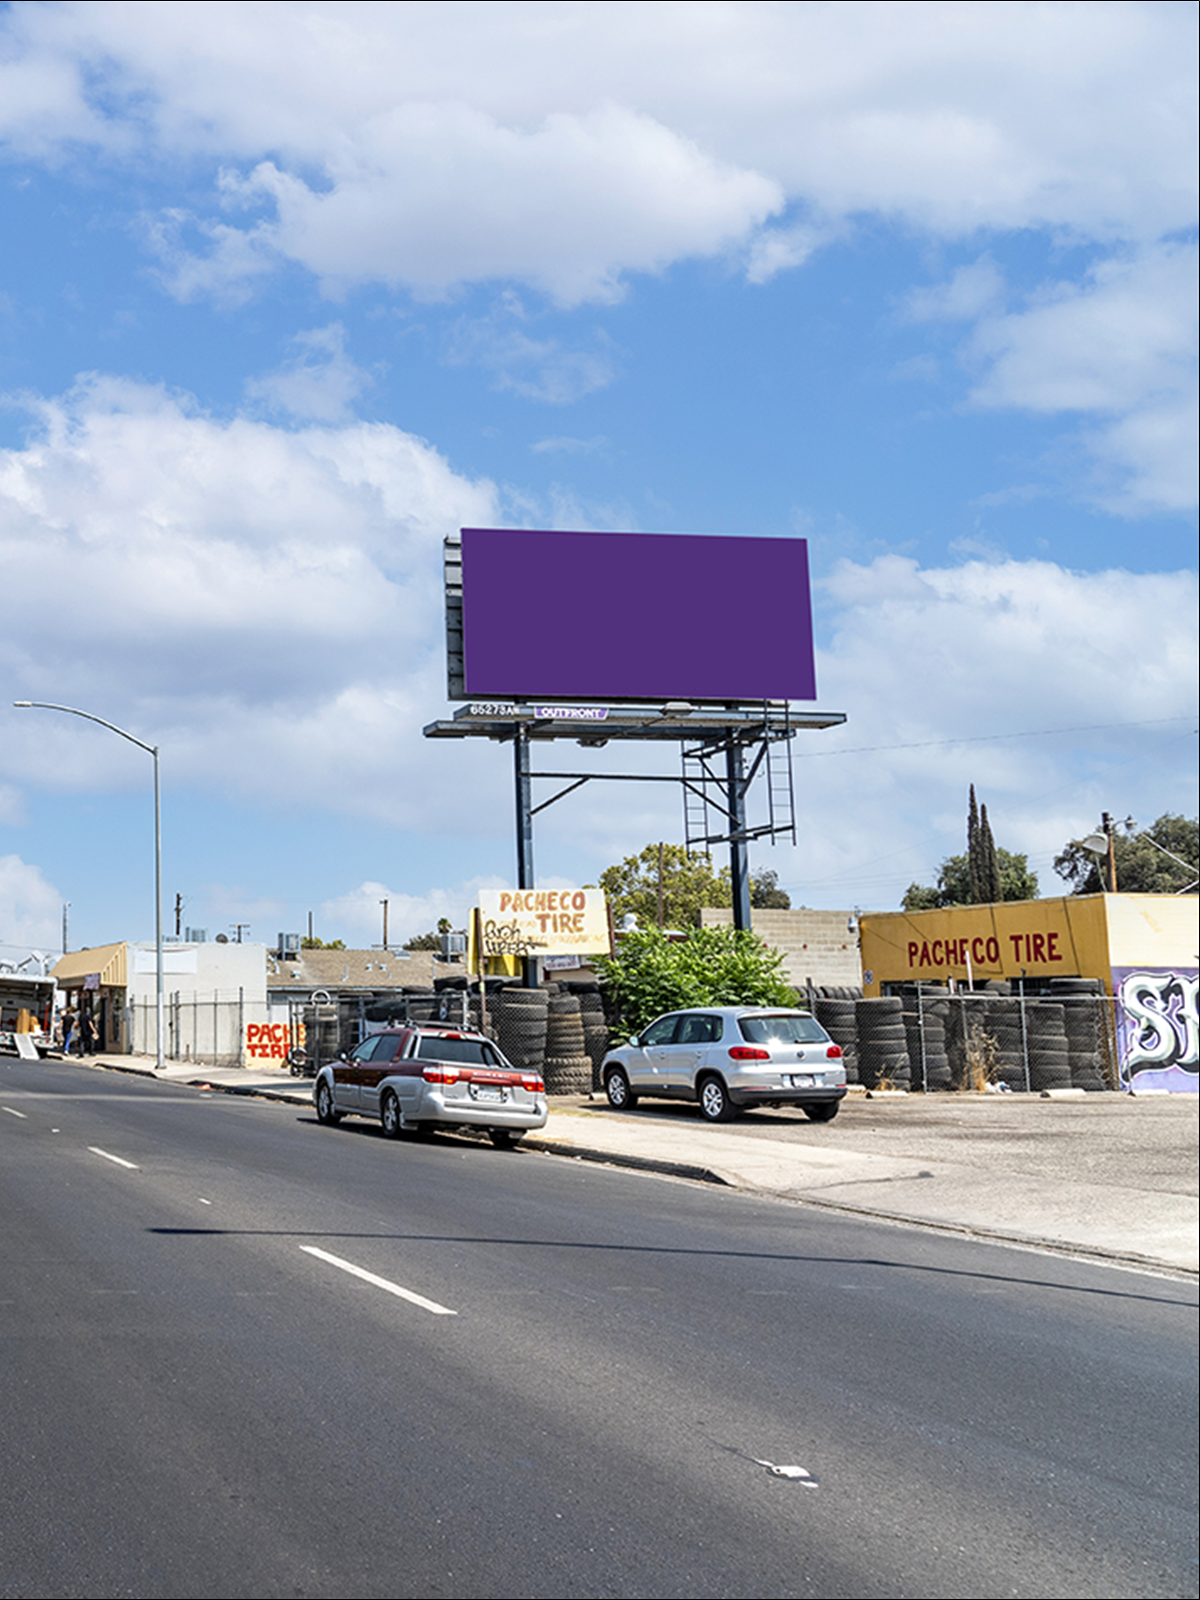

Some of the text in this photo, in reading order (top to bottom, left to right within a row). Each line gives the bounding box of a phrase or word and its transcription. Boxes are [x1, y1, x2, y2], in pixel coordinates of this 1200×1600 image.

[541, 706, 602, 719] OUTFRONT
[499, 891, 586, 912] PACHECO
[535, 912, 585, 933] TIRE
[907, 932, 1062, 967] PACHECO TIRE
